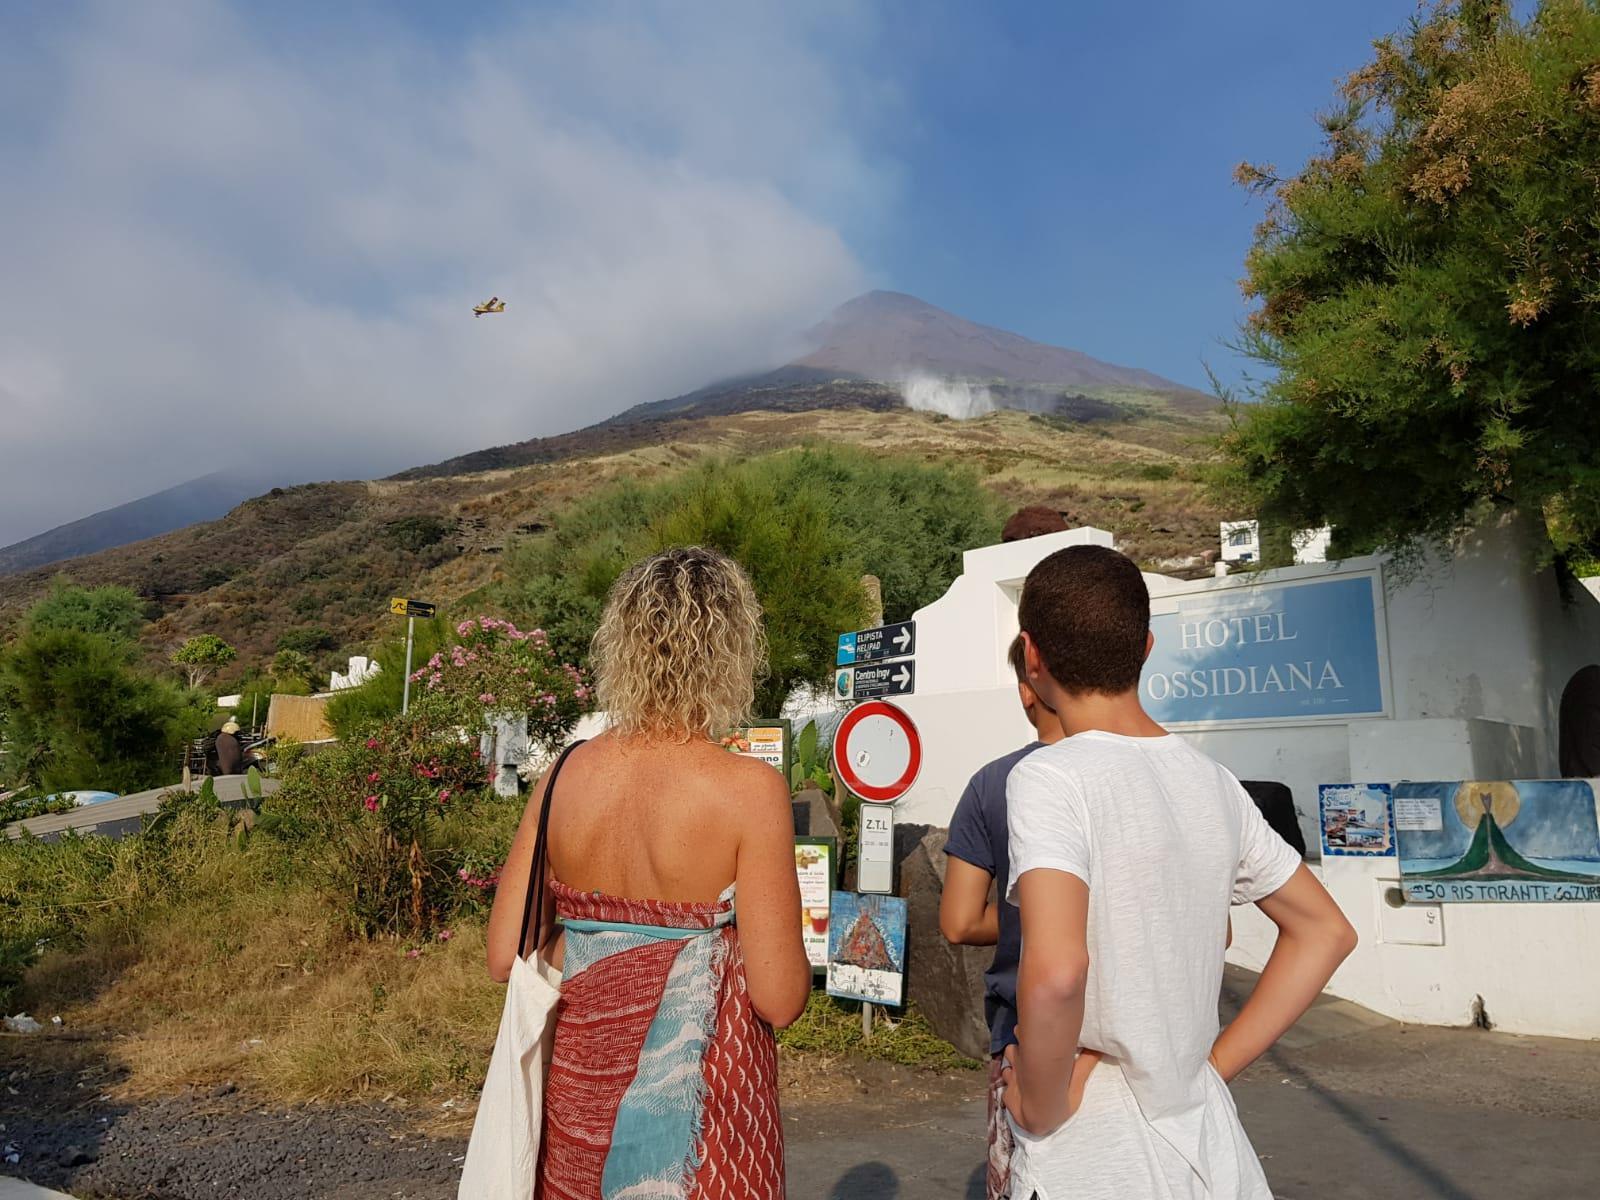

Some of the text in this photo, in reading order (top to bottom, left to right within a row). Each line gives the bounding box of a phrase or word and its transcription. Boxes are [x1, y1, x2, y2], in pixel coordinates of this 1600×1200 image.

[857, 631, 883, 643] ELIPISTA
[1179, 612, 1298, 650] HOTEL
[857, 641, 881, 653] HELIPAD
[855, 670, 876, 681] Centro
[1147, 659, 1345, 701] OSSIDIANA
[1451, 884, 1553, 901] RISTORANTE
